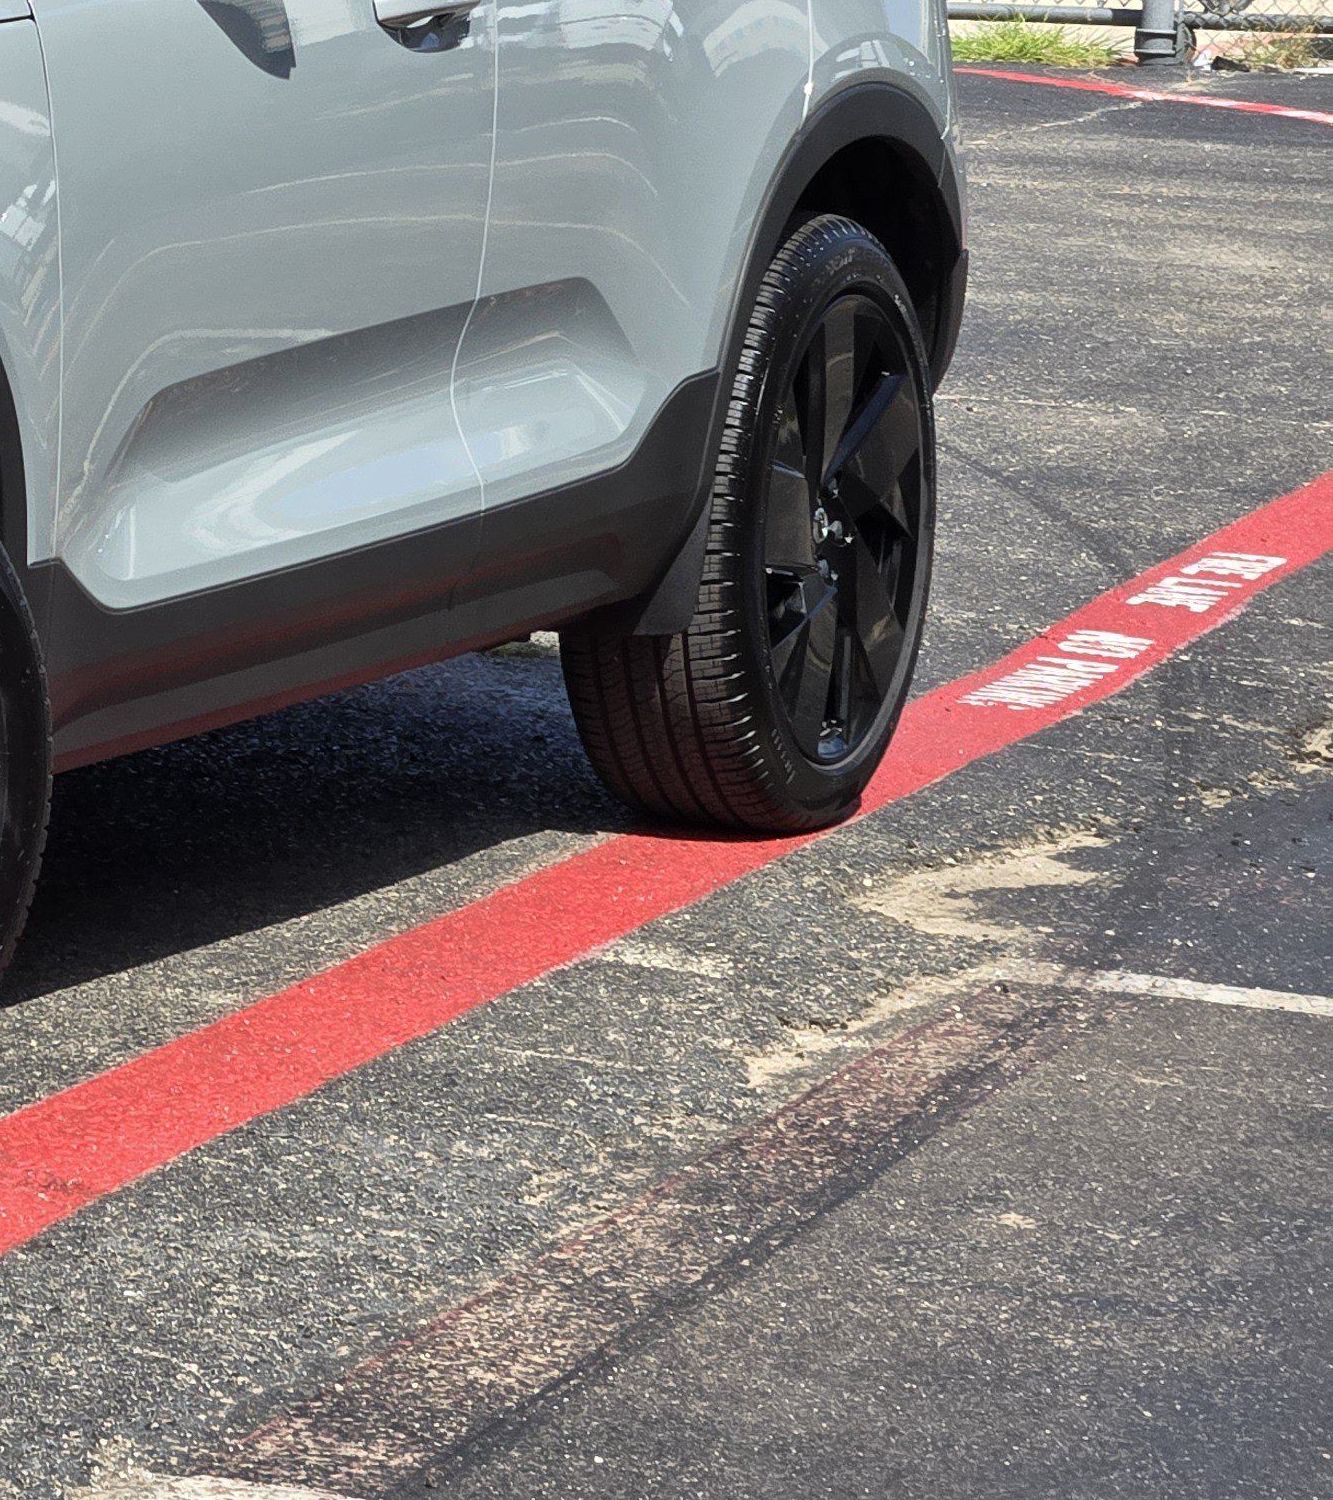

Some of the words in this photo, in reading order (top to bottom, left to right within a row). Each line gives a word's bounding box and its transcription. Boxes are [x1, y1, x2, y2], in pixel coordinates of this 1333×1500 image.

[1179, 551, 1289, 581] FIRE
[1125, 575, 1245, 613] LANE
[1056, 629, 1156, 659] NO
[956, 656, 1121, 711] PARKING
